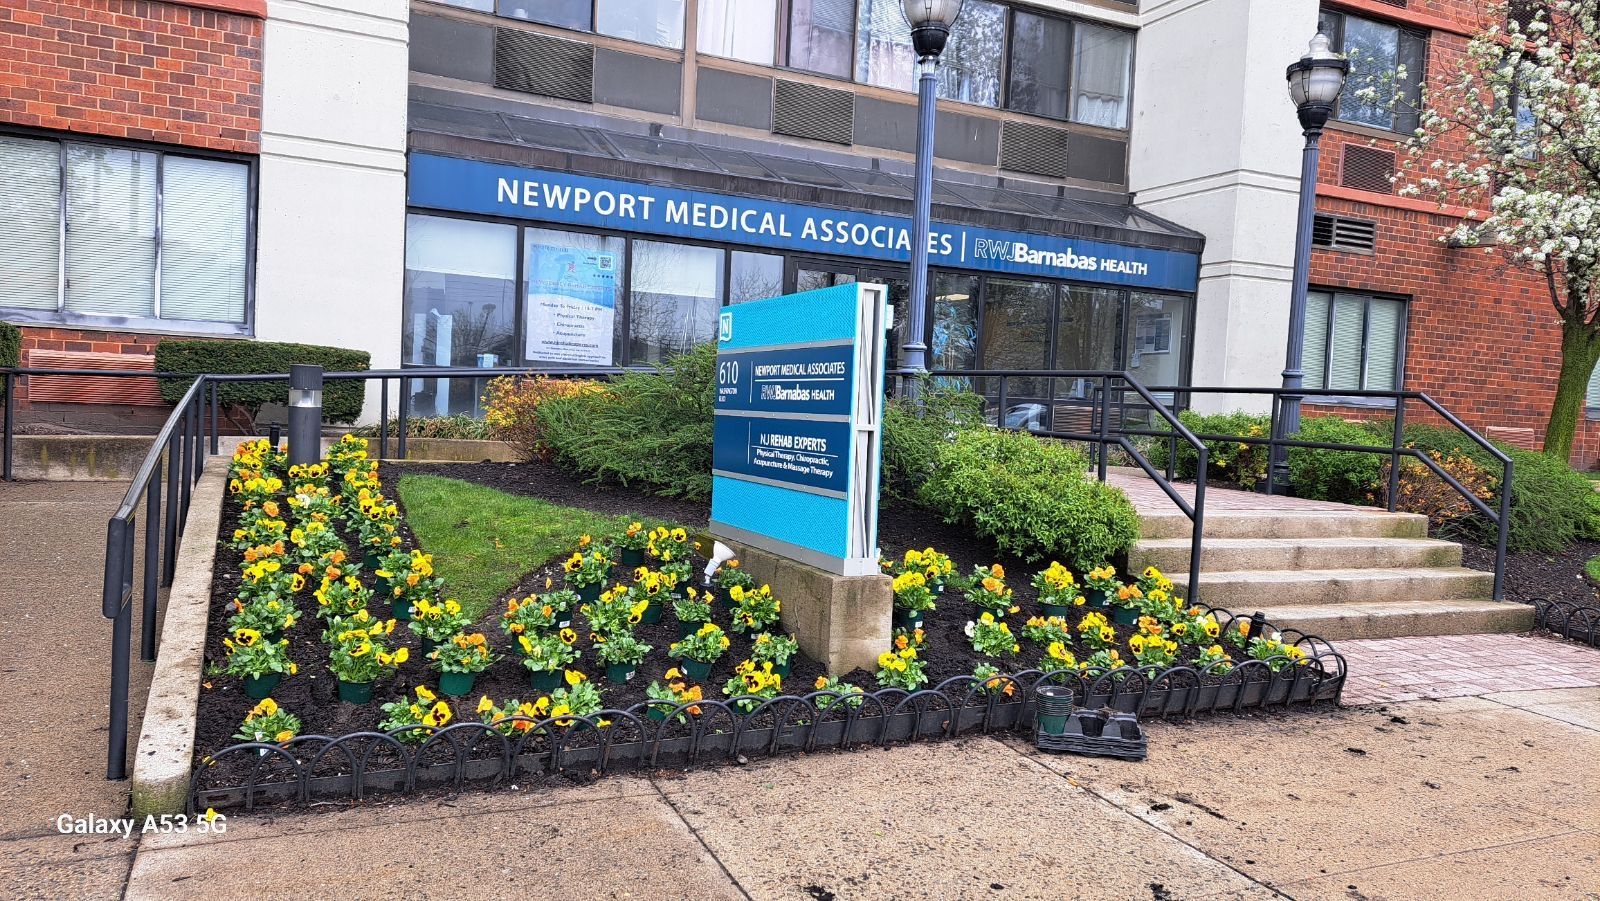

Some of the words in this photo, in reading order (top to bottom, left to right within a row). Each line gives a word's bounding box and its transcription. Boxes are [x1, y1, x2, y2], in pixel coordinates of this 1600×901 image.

[497, 177, 655, 220] NEWPORT
[665, 199, 792, 237] MEDICAL
[801, 217, 953, 256] ASSOCIAES
[1101, 259, 1148, 276] HEALTH
[719, 361, 739, 385] 610
[754, 364, 781, 377] NEWPORT
[781, 363, 806, 376] MEDICAL
[807, 361, 845, 375] ASSOCIATES
[811, 389, 835, 401] HEALTH
[760, 433, 770, 446] NJ
[771, 434, 793, 448] REHAB
[794, 436, 827, 452] EXPERTS
[756, 448, 775, 458] Physical
[775, 450, 796, 462] Therapy,
[796, 453, 830, 467] Chiropractic,
[753, 457, 783, 470] Acupuncture
[783, 461, 788, 470] &
[788, 463, 810, 475] Massage
[810, 466, 834, 479] Therapy
